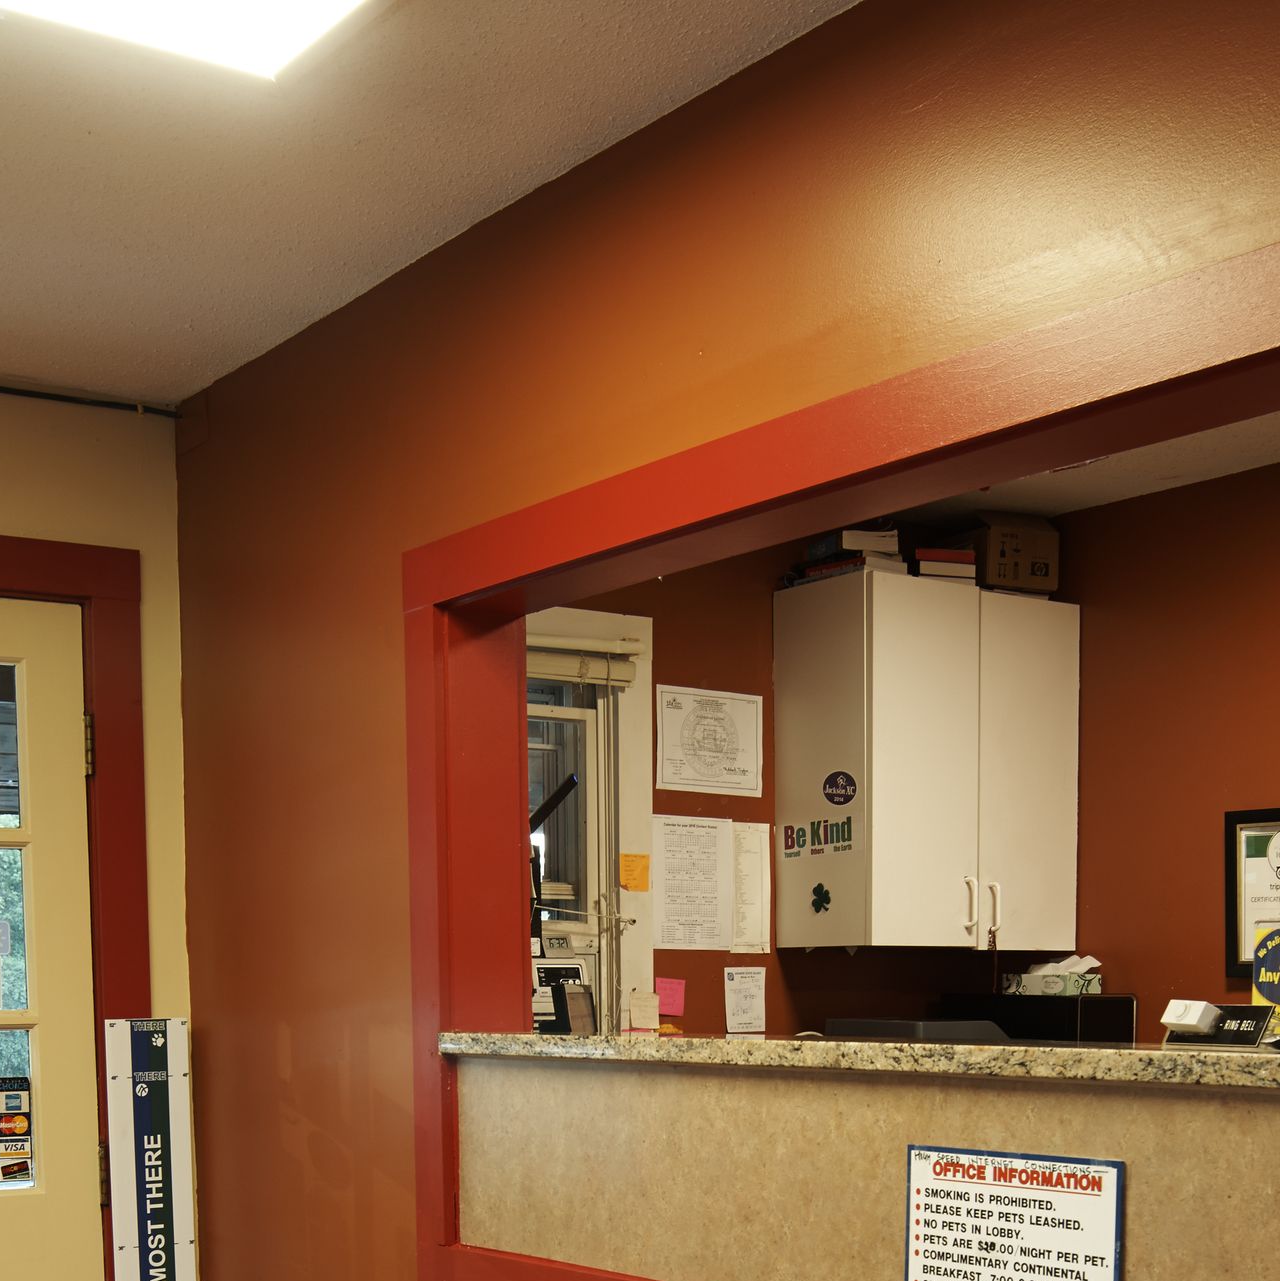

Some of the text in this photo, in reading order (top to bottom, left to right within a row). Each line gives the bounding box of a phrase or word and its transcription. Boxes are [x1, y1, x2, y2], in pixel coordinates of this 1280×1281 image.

[824, 784, 855, 795] Jackson XC
[784, 816, 852, 850] Be Kind
[132, 1021, 166, 1032] THERE
[134, 1070, 167, 1082] THERE
[4, 1143, 25, 1151] VISA
[143, 1134, 164, 1214] THERE
[937, 1153, 1092, 1175] SPEED INTERNET CONNECTIONS
[932, 1161, 1102, 1192] OFFICE INFORMATION
[924, 1187, 1056, 1211] SMOKING IS PROHIBITED.
[924, 1203, 1084, 1231] PLEASE KEEP PETS LEASHED.
[923, 1218, 1024, 1240] NO PETS IN LOBBY.
[923, 1234, 1109, 1268] PETS ARE PER PET.
[923, 1249, 1088, 1281] COMPLIMENTARY CONTINENTAL
[923, 1264, 982, 1281] BREAKFAST
